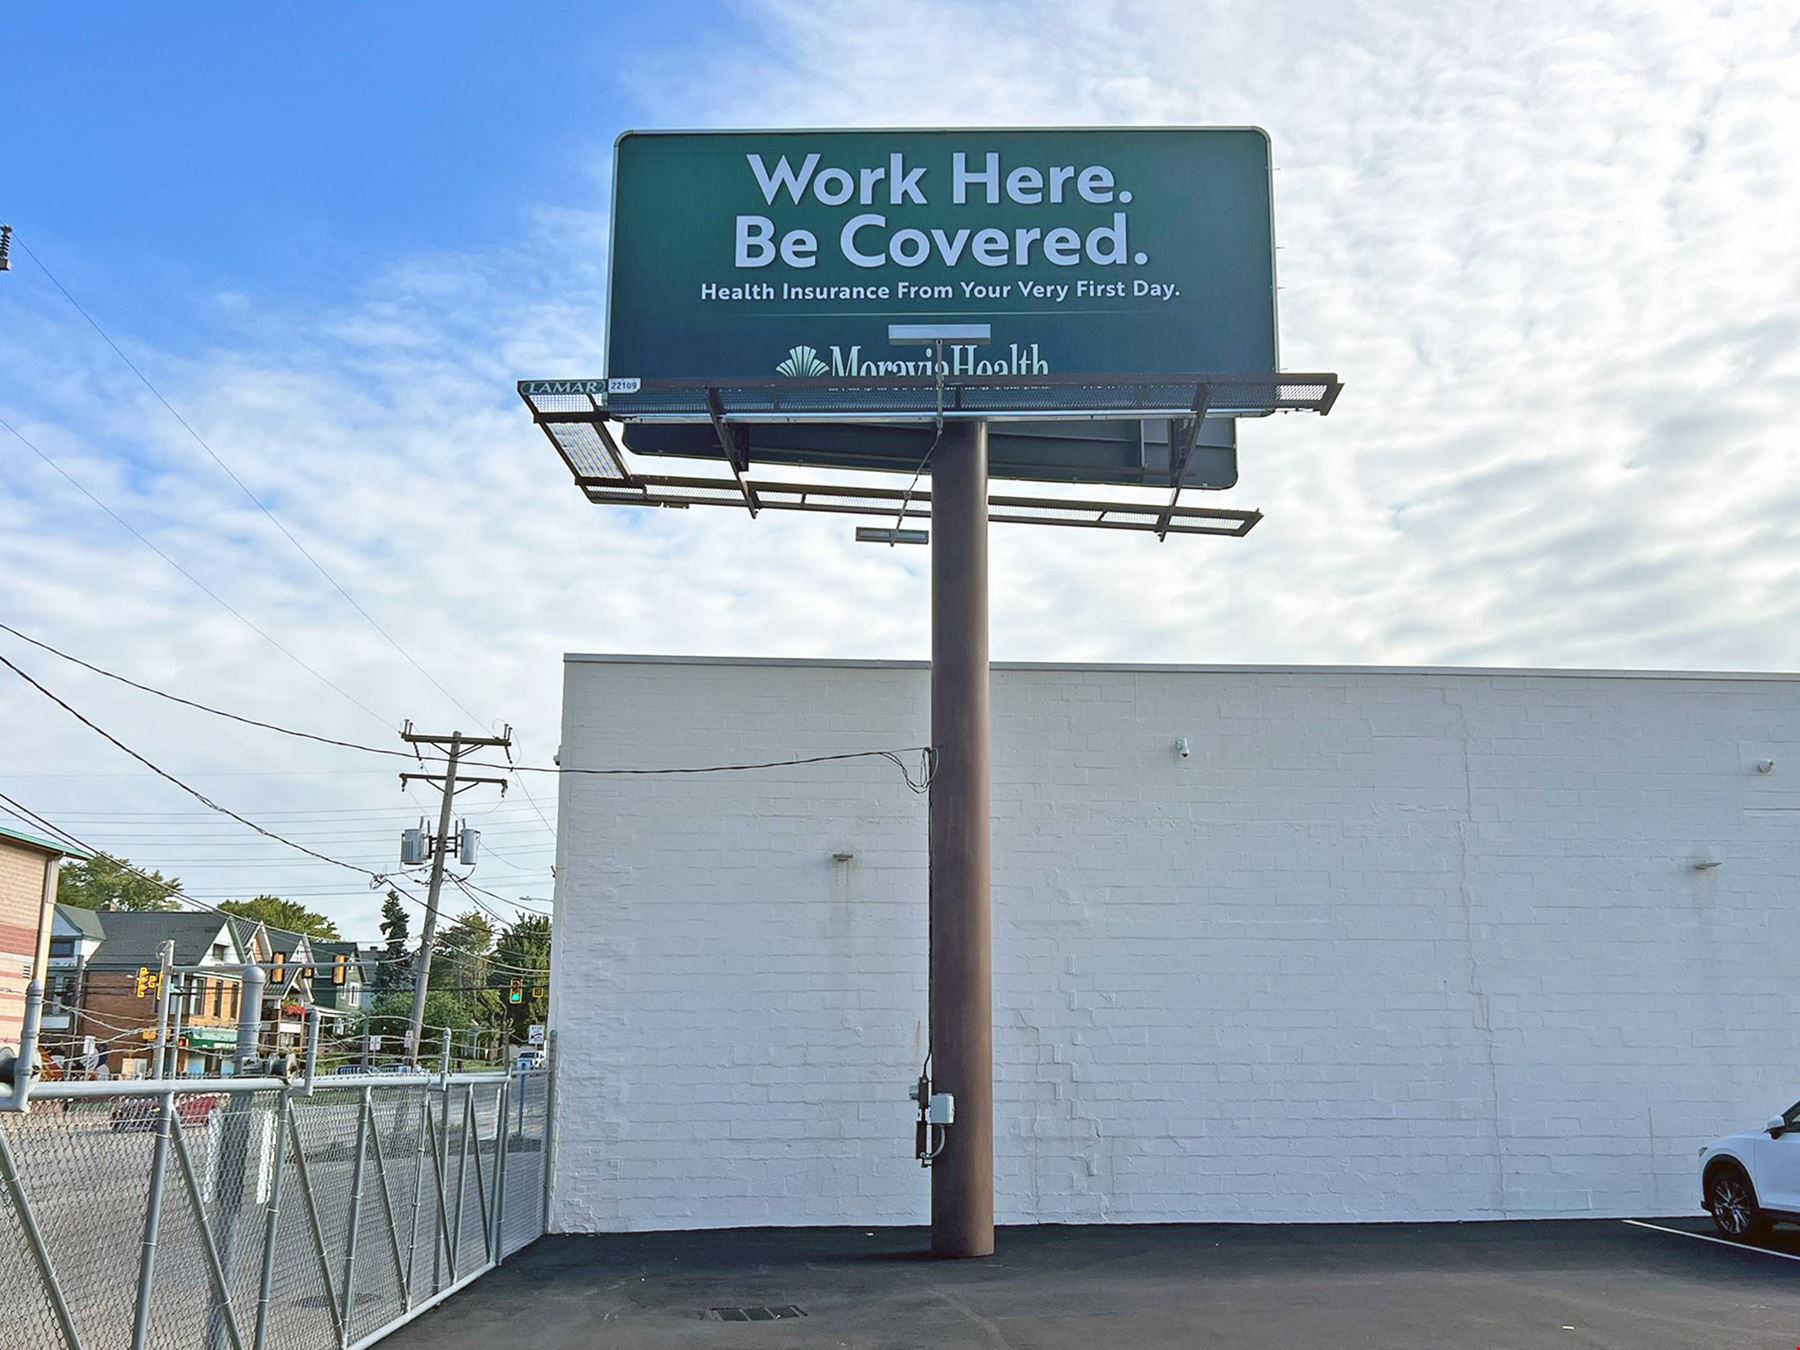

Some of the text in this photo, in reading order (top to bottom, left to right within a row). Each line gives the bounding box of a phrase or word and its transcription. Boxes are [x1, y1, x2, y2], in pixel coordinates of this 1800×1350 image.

[746, 152, 1133, 206] Work Here.
[735, 212, 1149, 268] Be Covered.
[701, 279, 1180, 302] Health Insurance From Your Very First Day.
[529, 382, 598, 394] LAMAR
[610, 381, 638, 390] 22109
